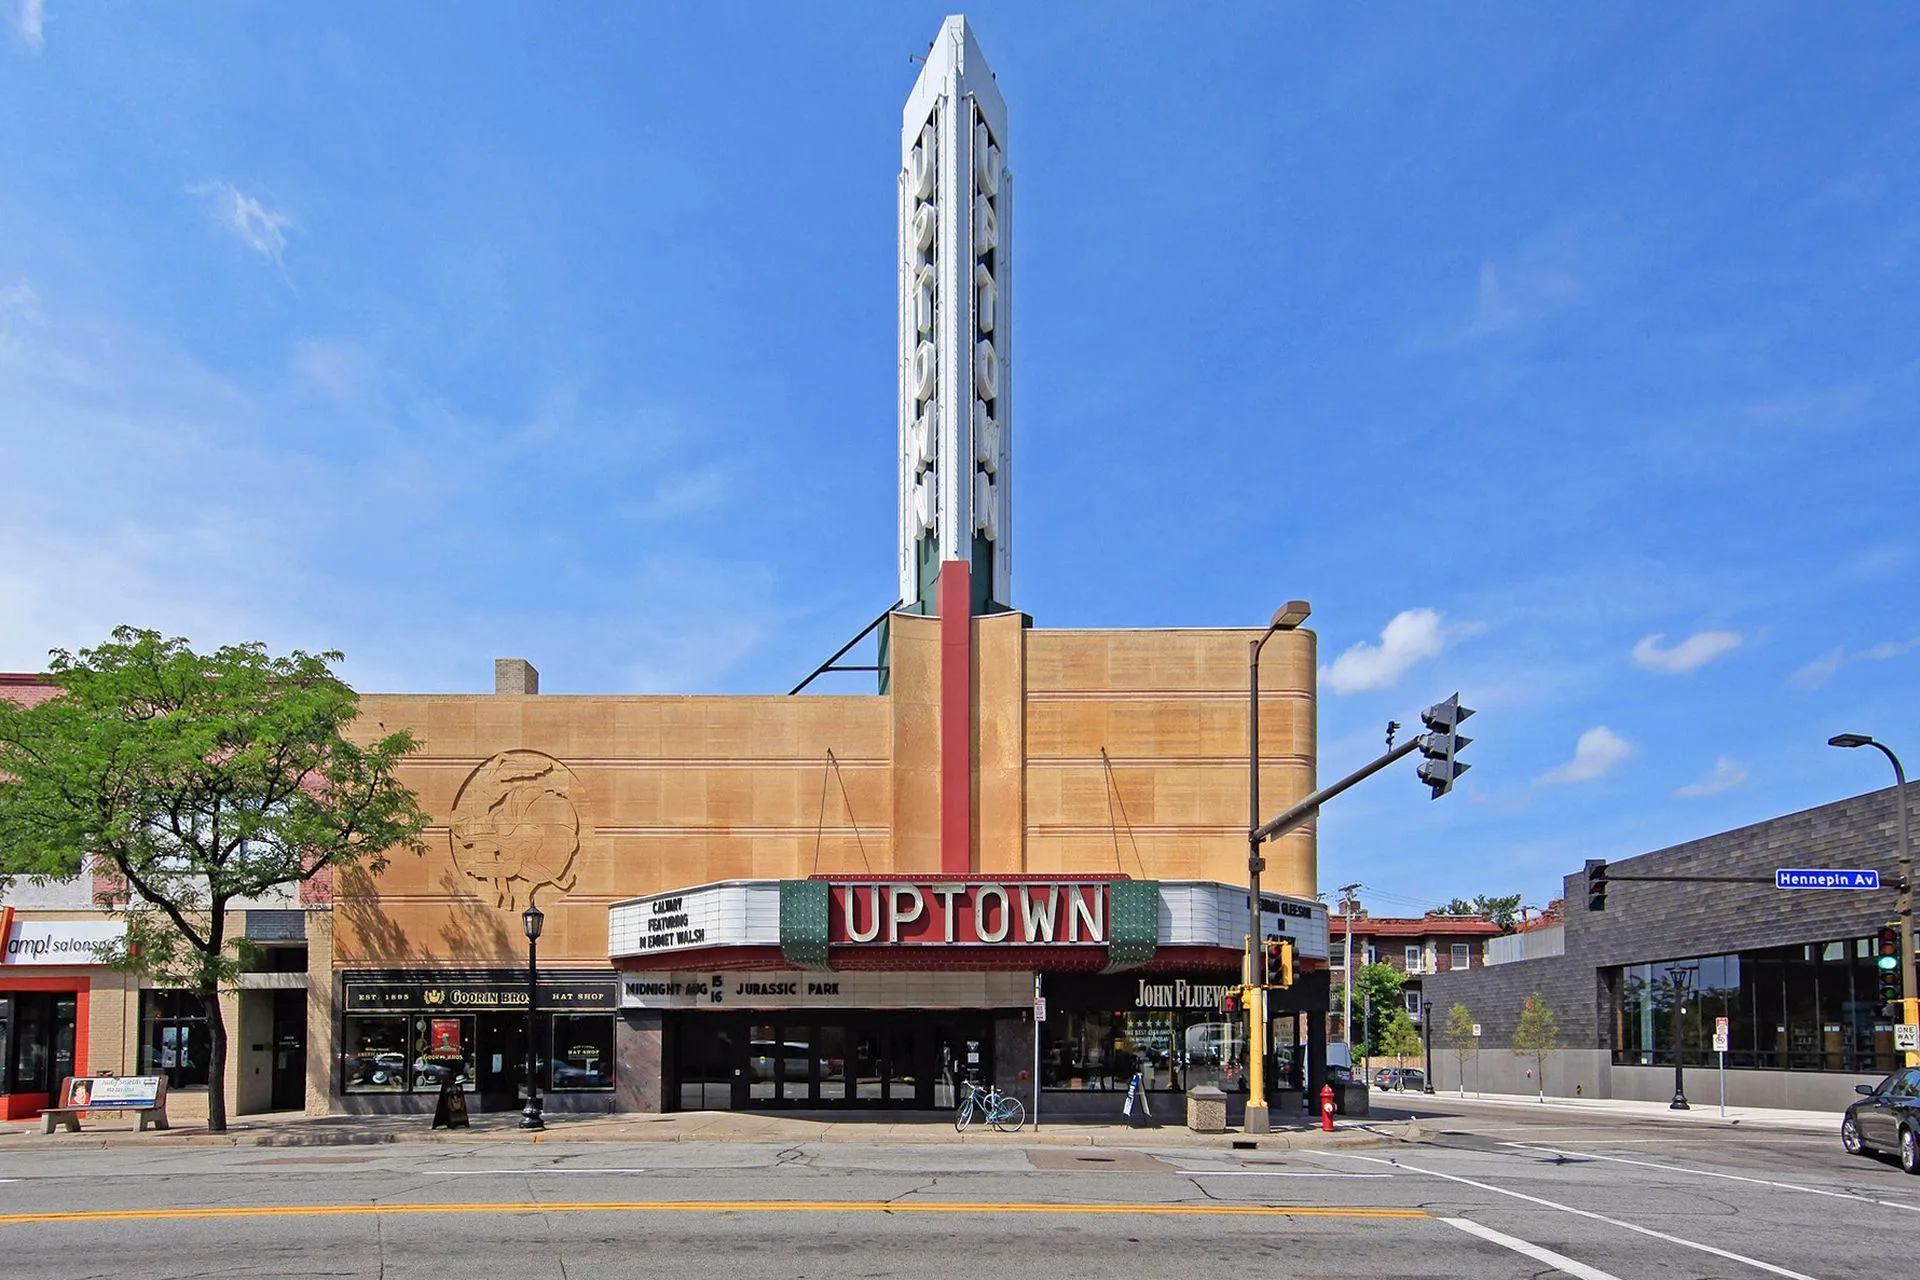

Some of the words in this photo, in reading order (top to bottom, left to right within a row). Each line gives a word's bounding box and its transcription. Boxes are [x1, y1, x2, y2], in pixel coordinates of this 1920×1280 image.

[1780, 873, 1848, 886] Hennepin
[1855, 874, 1873, 885] Av
[653, 897, 682, 915] CALVARY
[845, 884, 1103, 943] UPTOWN
[1281, 902, 1311, 919] GLEESON
[648, 913, 688, 932] FEATURING
[676, 928, 705, 945] WALSH
[8, 934, 51, 960] amp!
[626, 983, 681, 995] MIDNIGHT
[685, 983, 708, 995] AUG
[712, 976, 723, 987] 15
[736, 983, 796, 995] JURASSIC
[808, 983, 839, 995] PARK
[1135, 979, 1174, 1008] JOHN
[450, 989, 498, 1004] GOORIN
[711, 991, 723, 1003] 16
